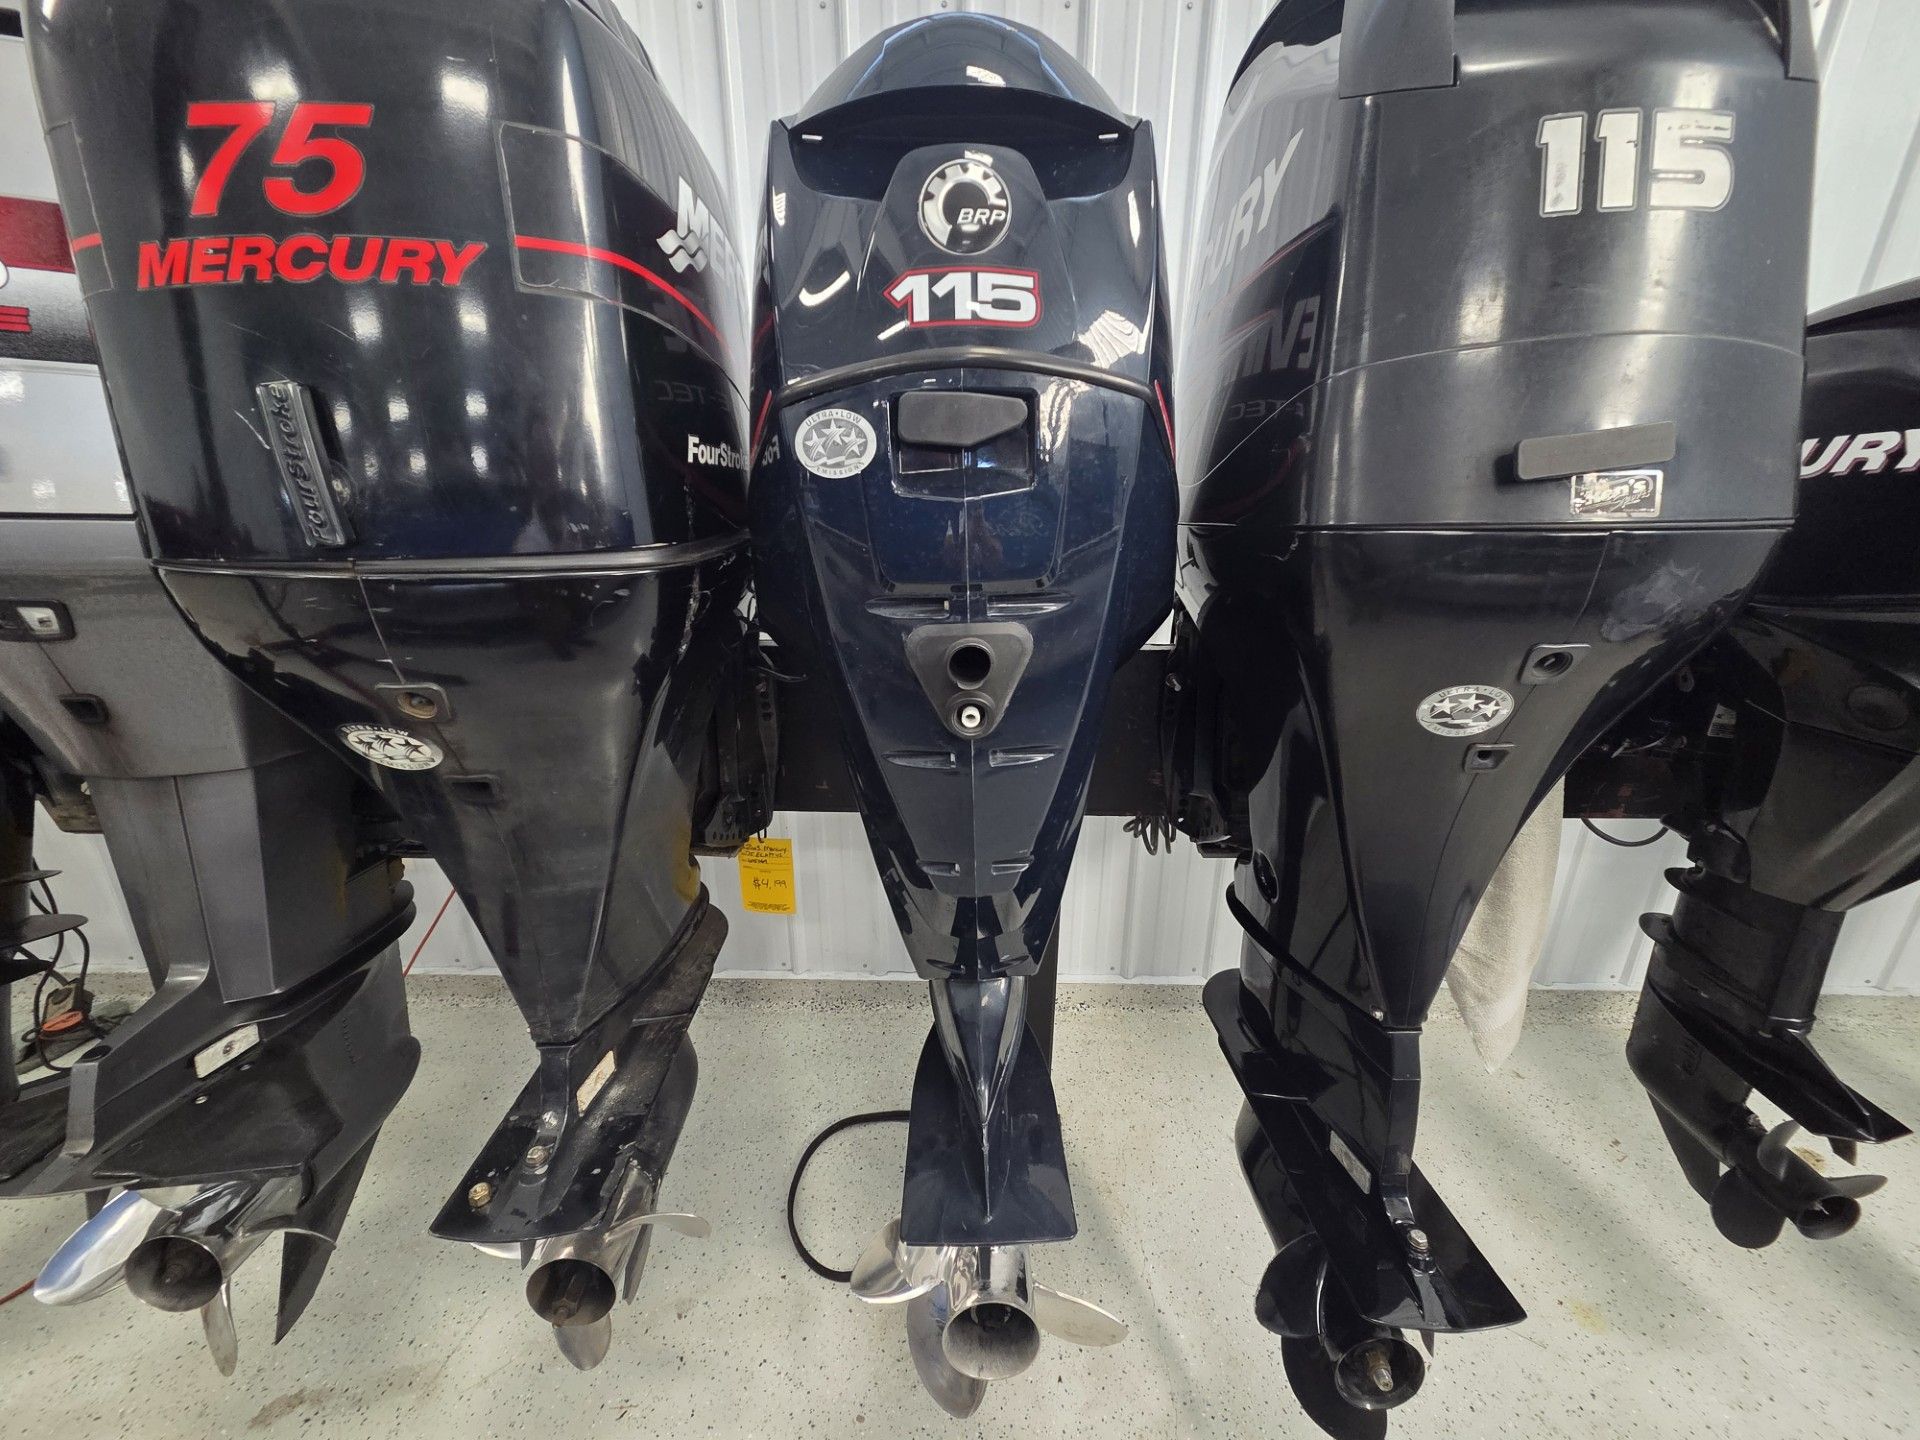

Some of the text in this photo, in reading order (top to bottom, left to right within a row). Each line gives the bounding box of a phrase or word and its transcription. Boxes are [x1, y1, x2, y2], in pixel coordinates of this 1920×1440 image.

[187, 102, 373, 217] 75
[1536, 107, 1735, 218] 115
[957, 207, 1006, 225] BRP
[138, 234, 488, 290] MERCURY
[884, 266, 1042, 327] 115
